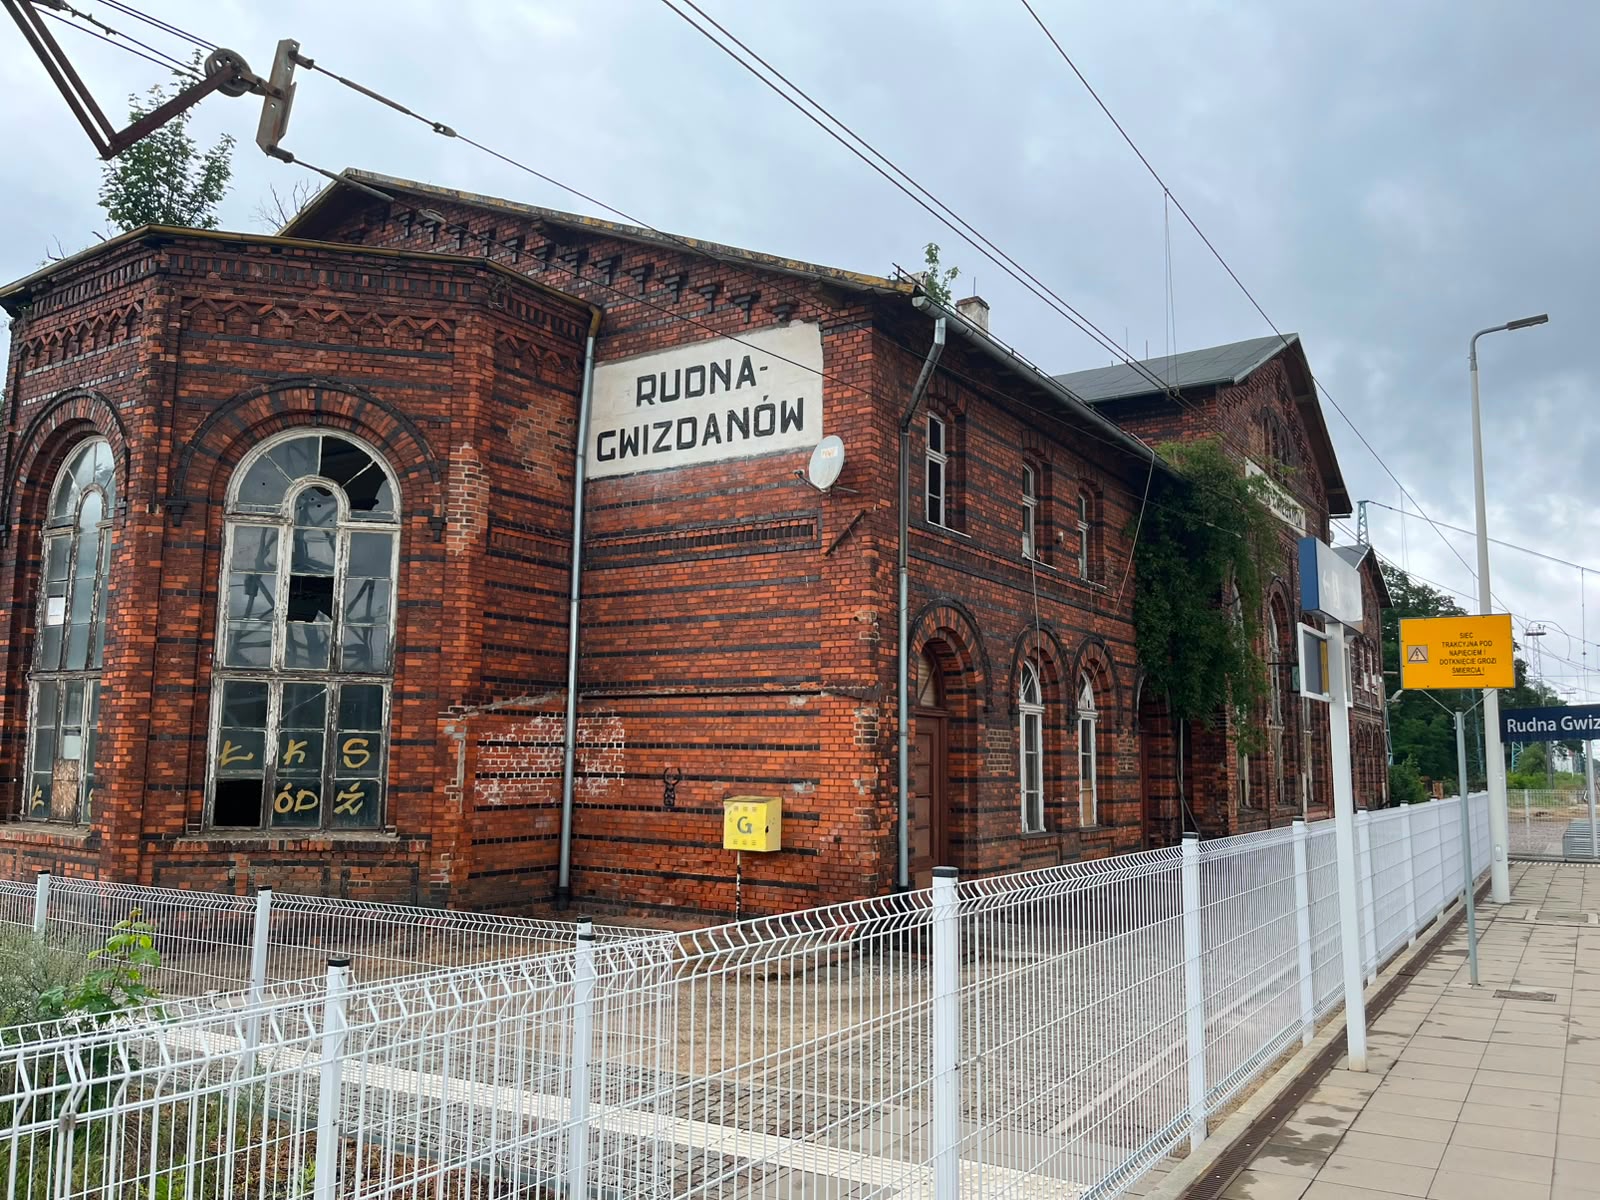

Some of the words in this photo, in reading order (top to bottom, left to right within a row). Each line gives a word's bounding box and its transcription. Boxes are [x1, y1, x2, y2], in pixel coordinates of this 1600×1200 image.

[636, 355, 768, 407] RUDNA-
[596, 395, 804, 462] GWIZDANÓW
[1507, 717, 1557, 733] Rudna
[736, 815, 753, 835] G
